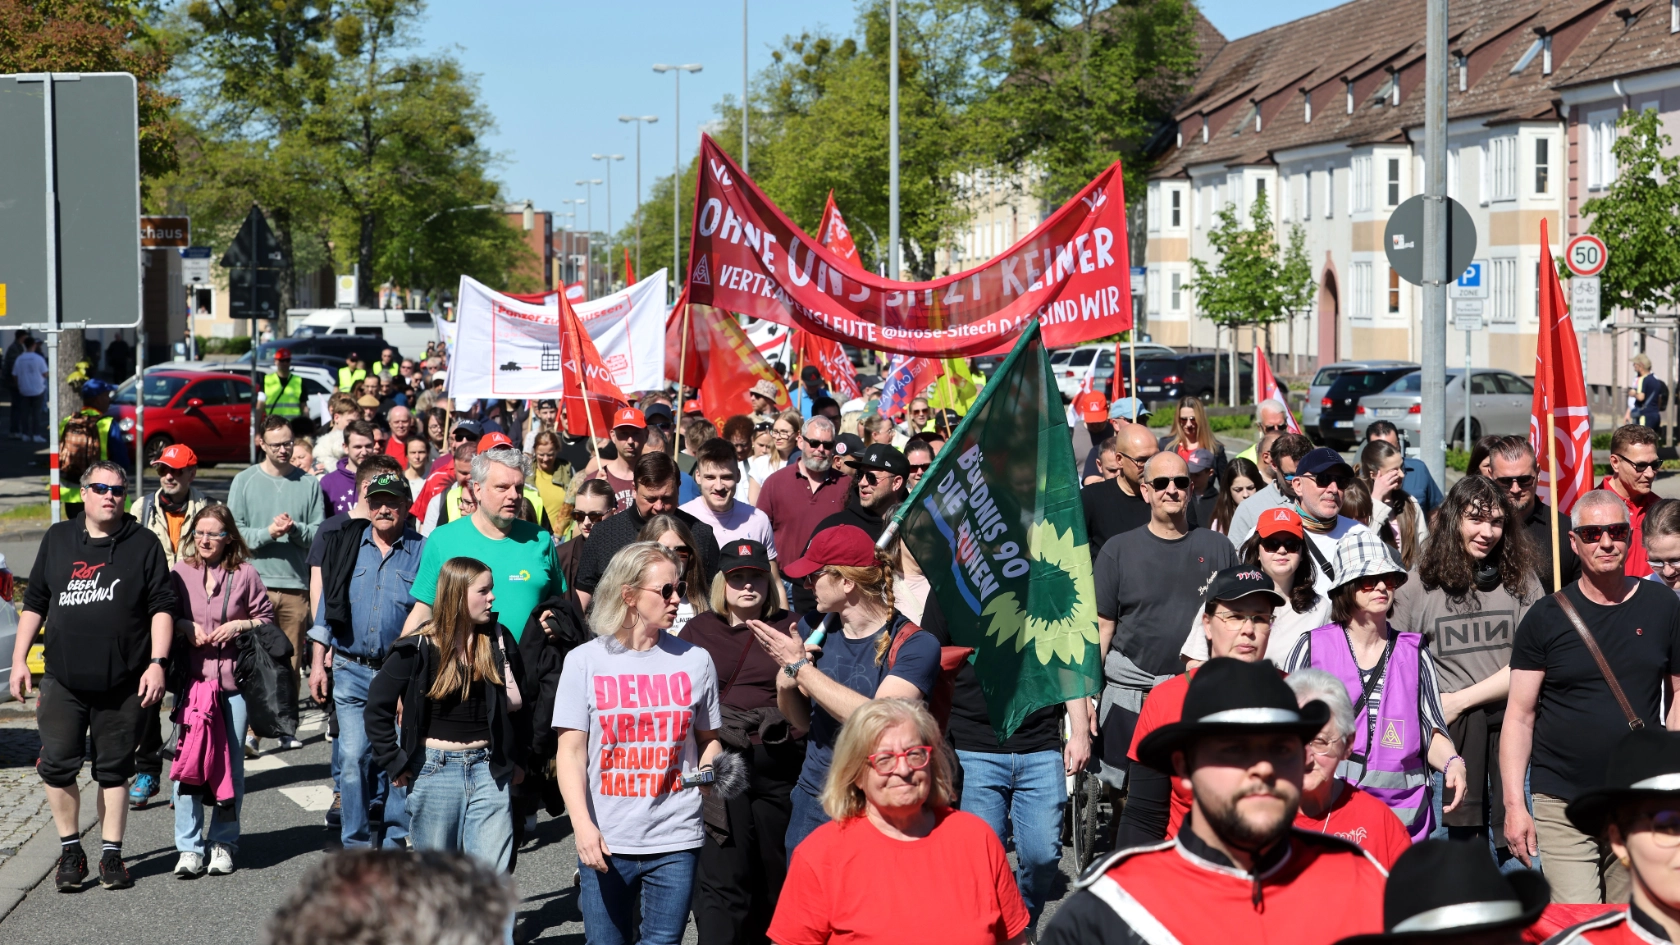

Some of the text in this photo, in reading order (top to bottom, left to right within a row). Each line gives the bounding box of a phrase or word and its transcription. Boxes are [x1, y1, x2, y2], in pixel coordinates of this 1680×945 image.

[700, 198, 776, 274] OHNE
[1001, 227, 1115, 297] KEINER
[1575, 246, 1598, 264] 50
[719, 264, 877, 342] VERTRAUENSLEUTE
[881, 320, 996, 339] @brose-Sitech
[1000, 312, 1032, 337] DAS
[1037, 299, 1078, 326] SIND
[1080, 286, 1120, 321] WIR
[1459, 289, 1479, 297] ZONE
[498, 305, 541, 322] Panzer
[937, 469, 1000, 602] DIE RÜNEN
[71, 561, 106, 580] ROT
[993, 541, 1030, 579] 90
[58, 578, 121, 606] RASSISMUS
[67, 572, 101, 591] GEGEN
[593, 671, 693, 710] DEMO
[600, 768, 684, 798] HALTUNG
